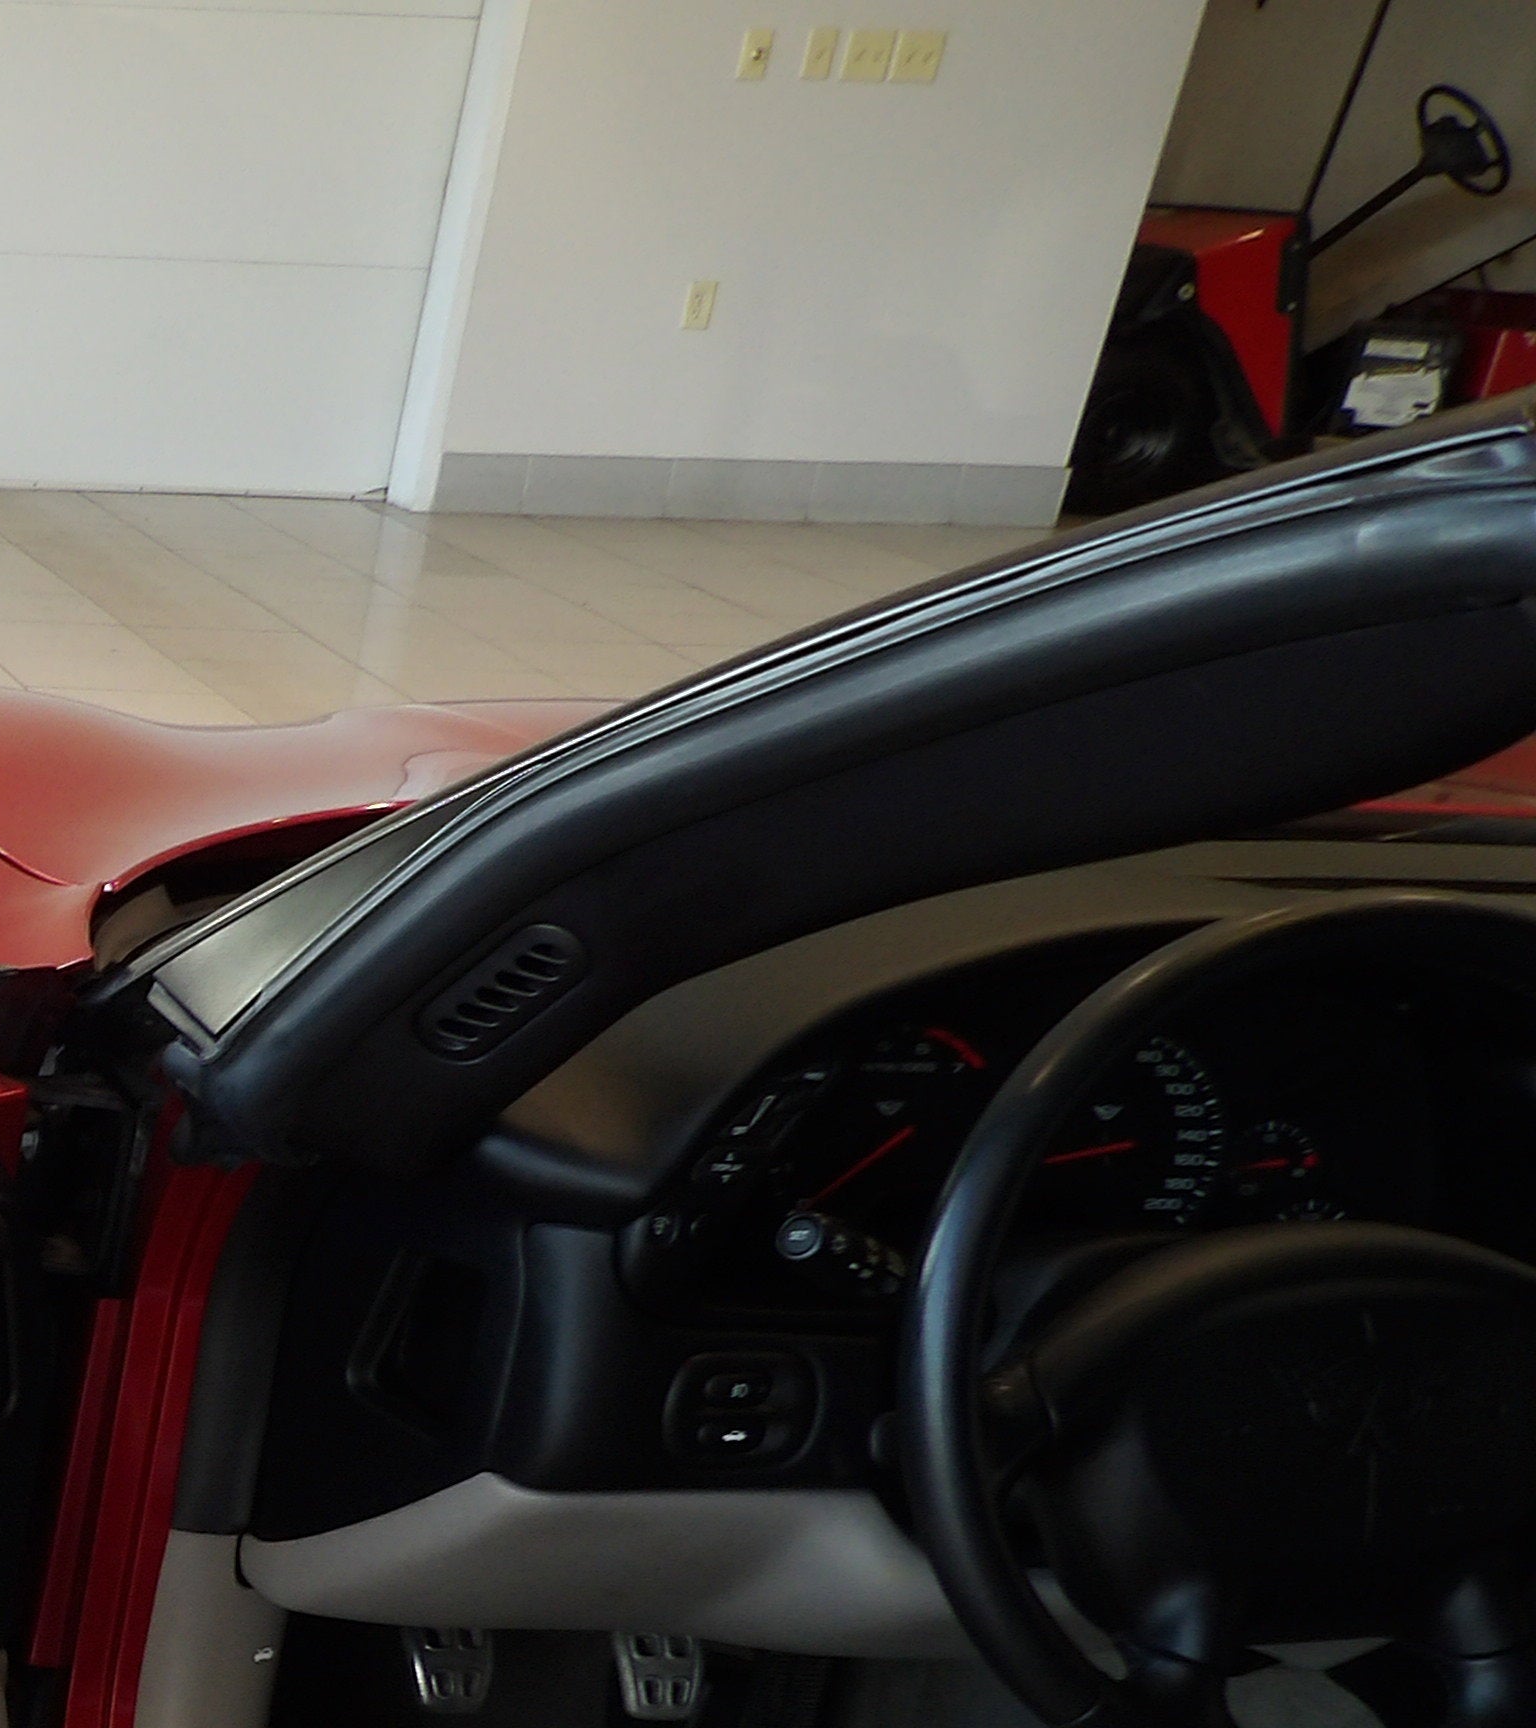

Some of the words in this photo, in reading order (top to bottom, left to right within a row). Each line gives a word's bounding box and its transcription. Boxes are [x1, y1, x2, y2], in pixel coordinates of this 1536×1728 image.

[1165, 1083, 1195, 1096] 100
[1175, 1104, 1205, 1118] 120
[1177, 1129, 1209, 1142] 140
[1143, 1198, 1183, 1211] 200
